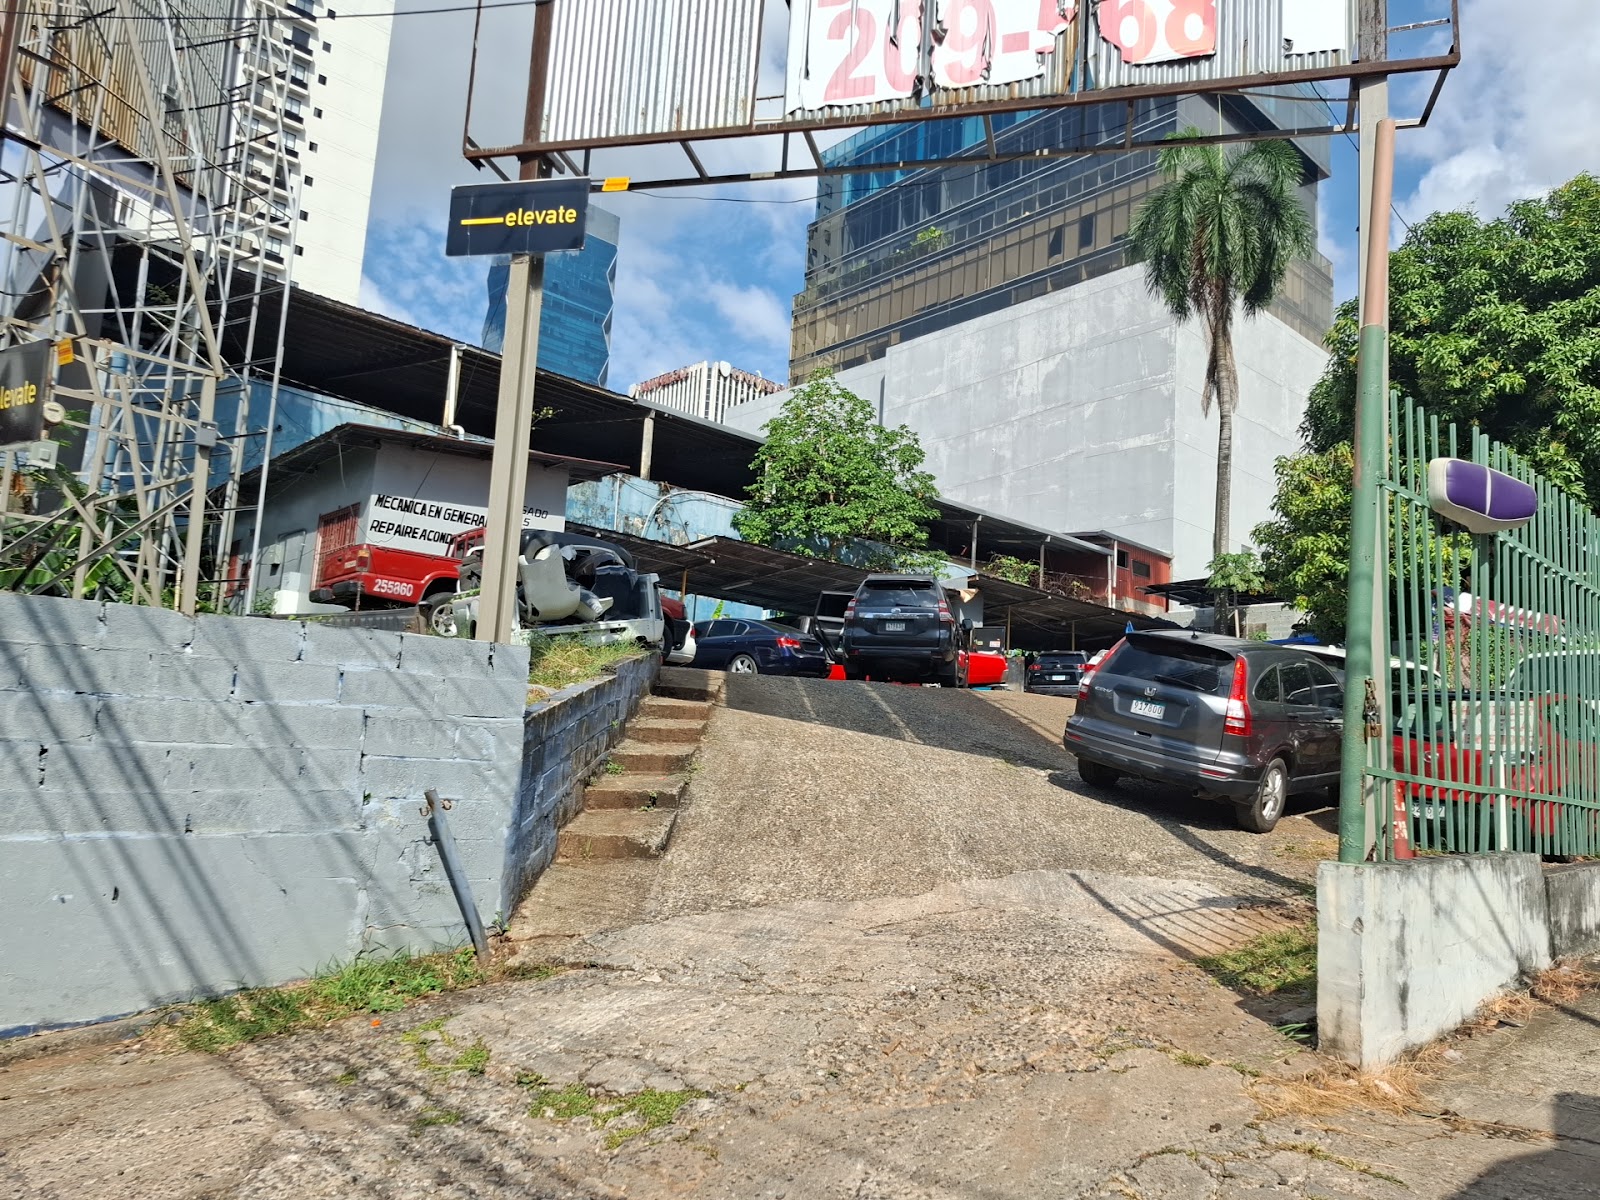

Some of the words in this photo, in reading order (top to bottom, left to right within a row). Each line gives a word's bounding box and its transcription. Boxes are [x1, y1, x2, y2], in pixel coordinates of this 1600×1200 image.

[505, 205, 577, 226] elevate
[0, 380, 37, 409] levate
[374, 494, 427, 516] MECANICA
[428, 504, 443, 519] EN
[443, 508, 488, 527] GENERA
[373, 578, 414, 597] 255860
